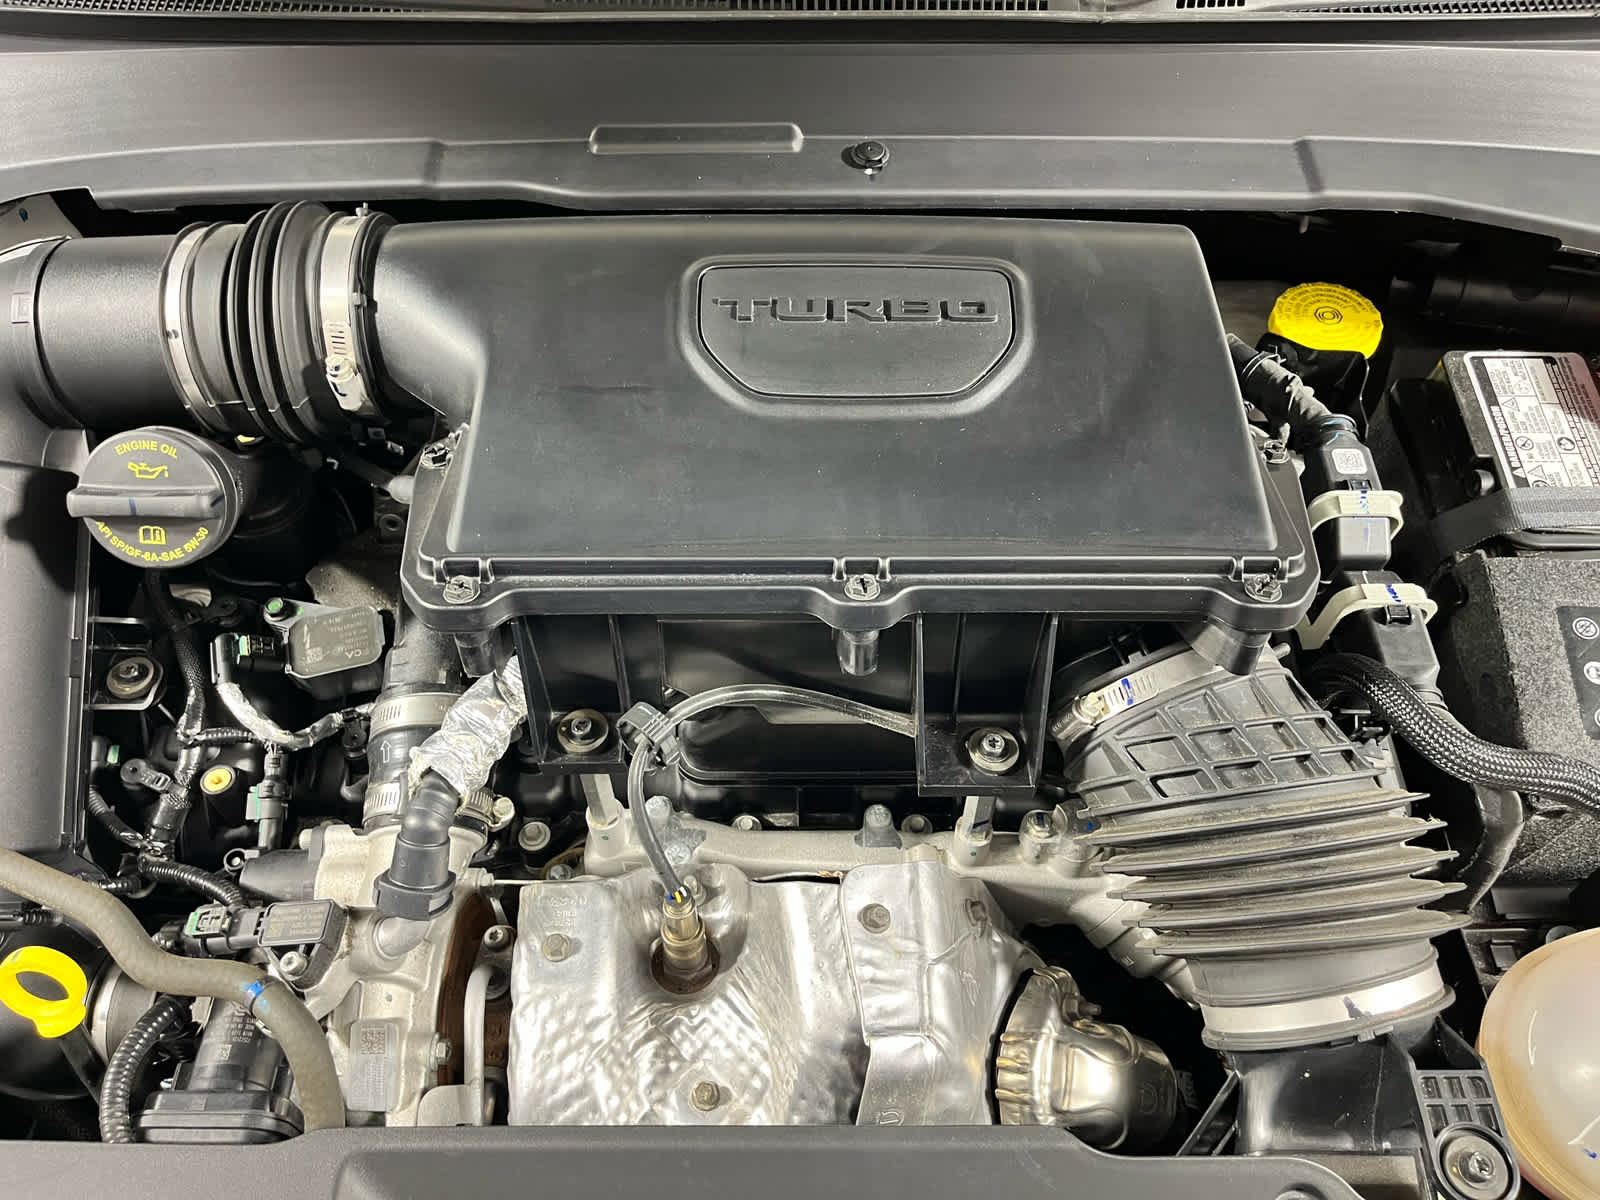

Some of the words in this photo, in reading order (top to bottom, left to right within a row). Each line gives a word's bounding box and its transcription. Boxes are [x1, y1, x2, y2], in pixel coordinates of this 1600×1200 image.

[712, 296, 998, 323] TURBO
[114, 440, 158, 456] ENGINE
[160, 443, 179, 460] OIL
[95, 521, 113, 539] API
[184, 526, 209, 553] 5W-30
